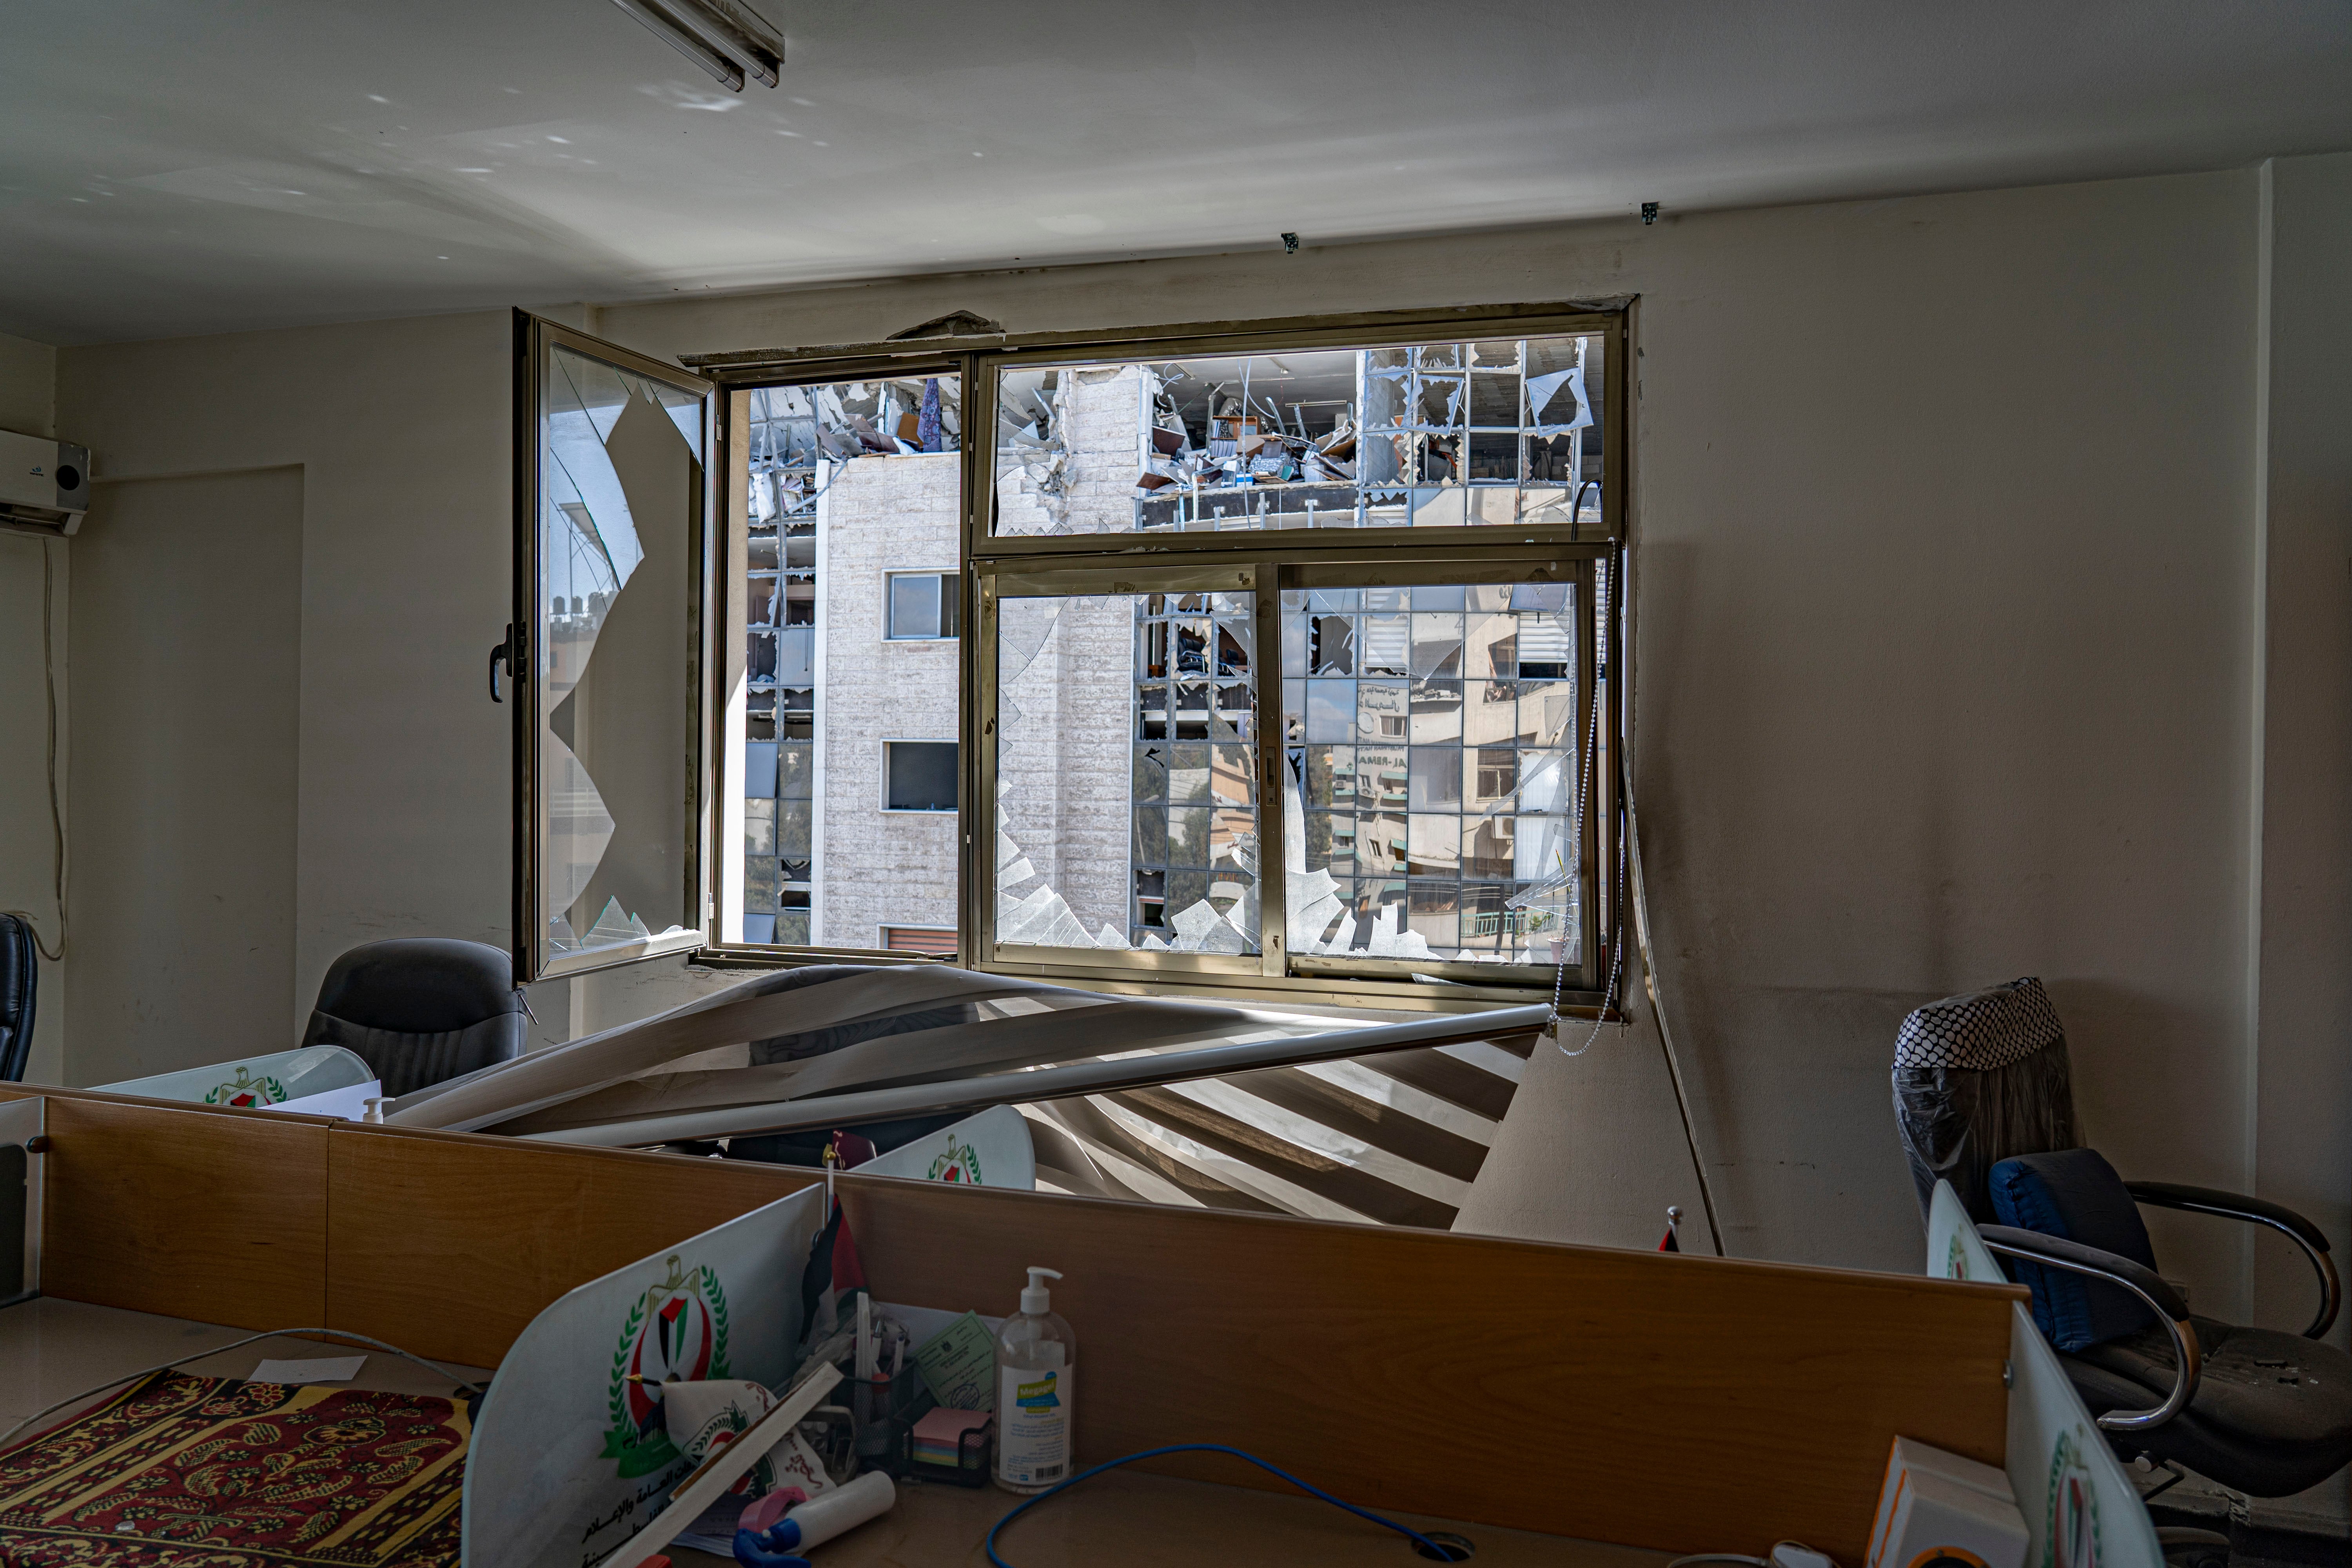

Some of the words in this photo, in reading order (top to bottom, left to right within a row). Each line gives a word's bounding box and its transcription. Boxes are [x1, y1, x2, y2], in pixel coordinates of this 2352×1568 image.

[1020, 1381, 1054, 1396] Megagel
[636, 1470, 673, 1503] العامة
[582, 1499, 633, 1543] والإعلام
